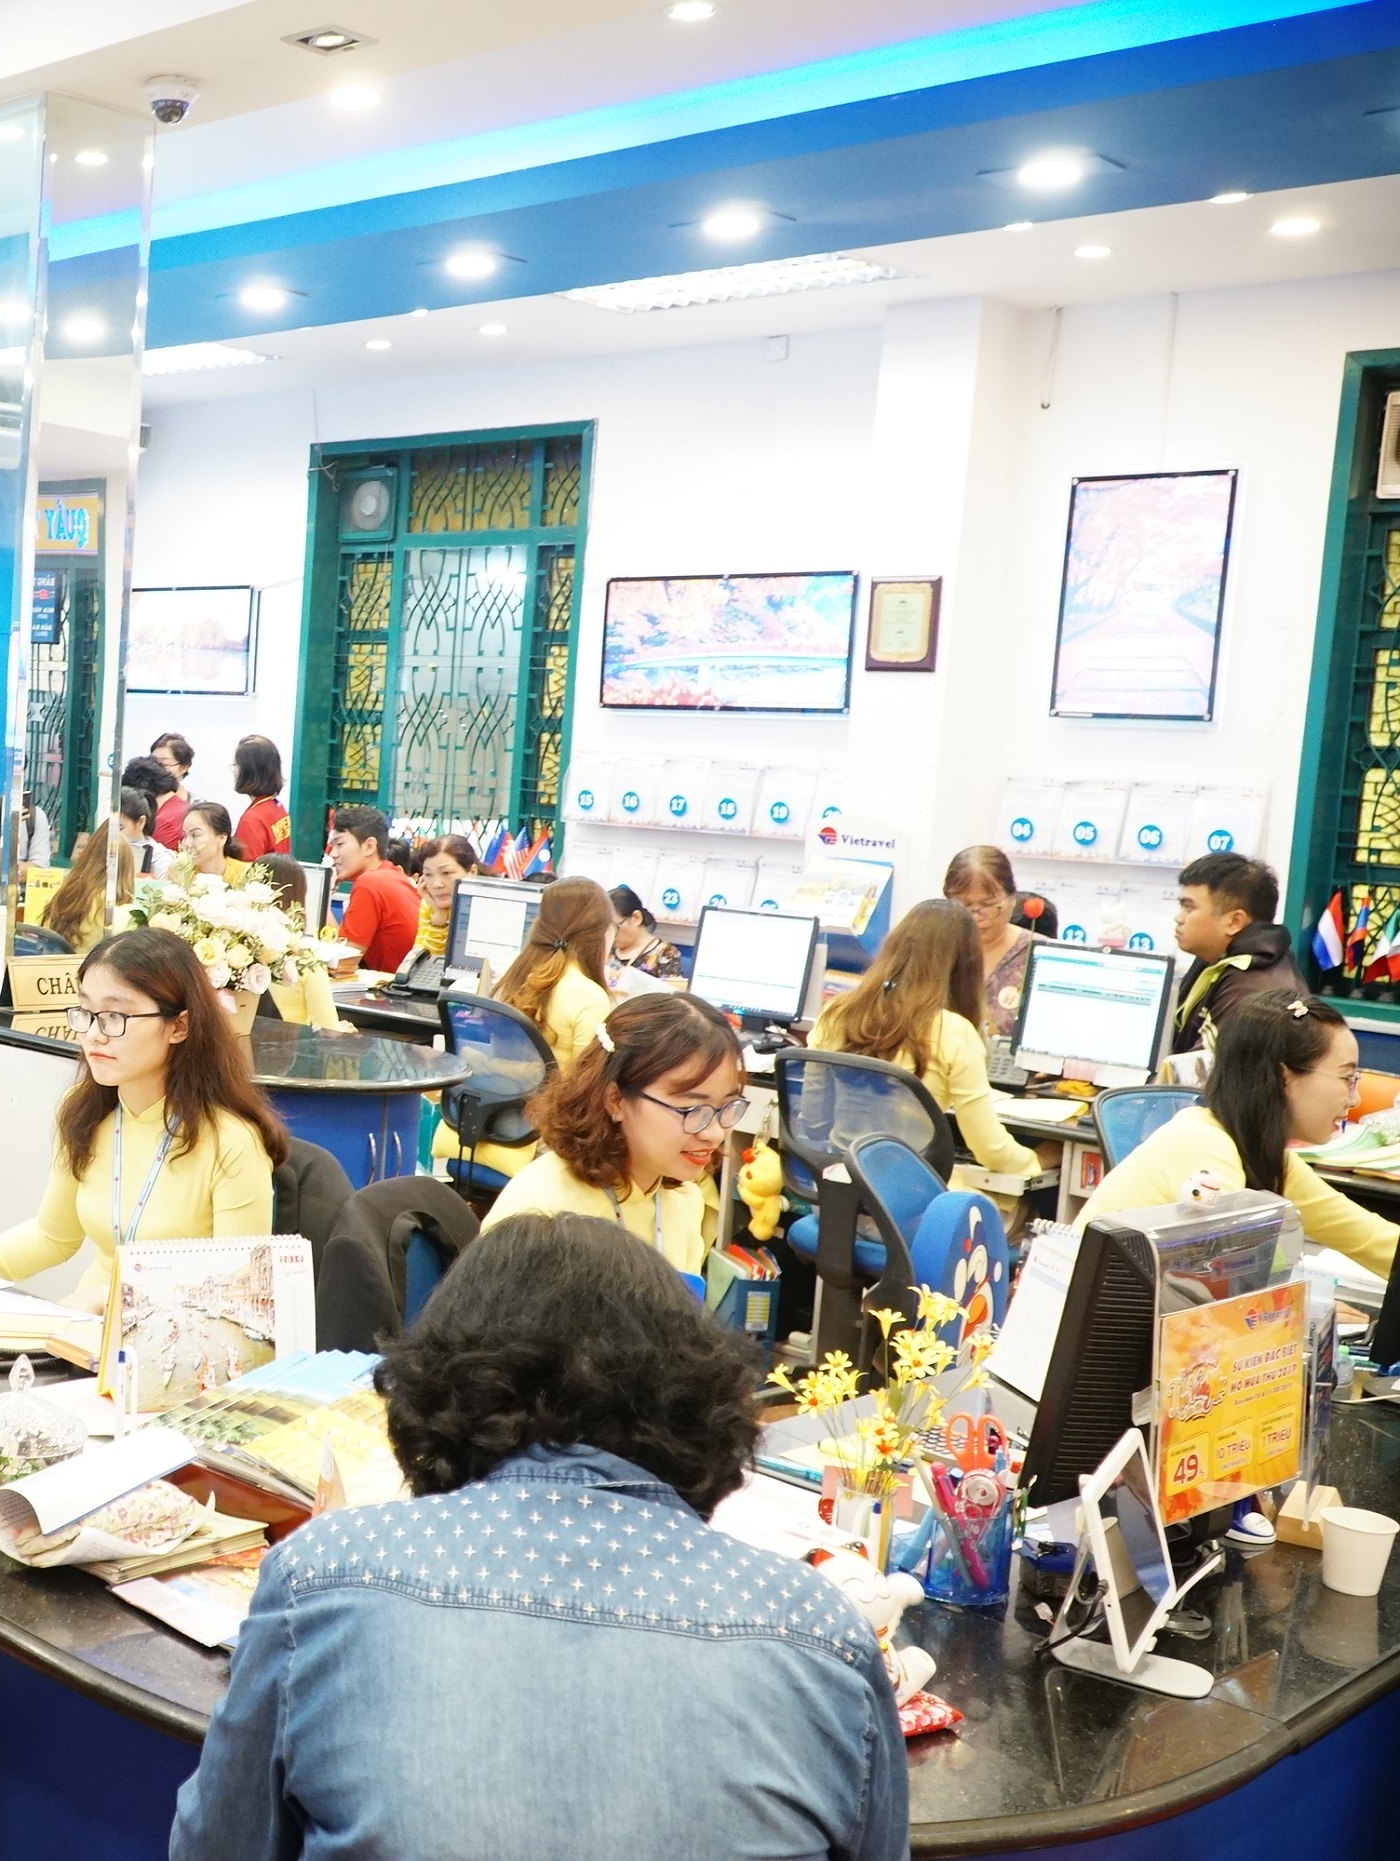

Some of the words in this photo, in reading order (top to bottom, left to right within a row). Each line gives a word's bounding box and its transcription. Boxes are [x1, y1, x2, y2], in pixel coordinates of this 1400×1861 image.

[580, 794, 592, 806] 15
[624, 796, 638, 808] 16
[670, 799, 686, 812] 17
[720, 802, 736, 815] 18
[772, 805, 788, 819] 19
[1011, 823, 1032, 837] 04
[1076, 827, 1096, 840] 05
[1140, 830, 1161, 844] 06
[842, 834, 896, 848] Vietravel
[1209, 836, 1230, 850] 07
[664, 892, 678, 904] 23
[36, 972, 80, 996] CHÂ
[1173, 1454, 1198, 1484] 49
